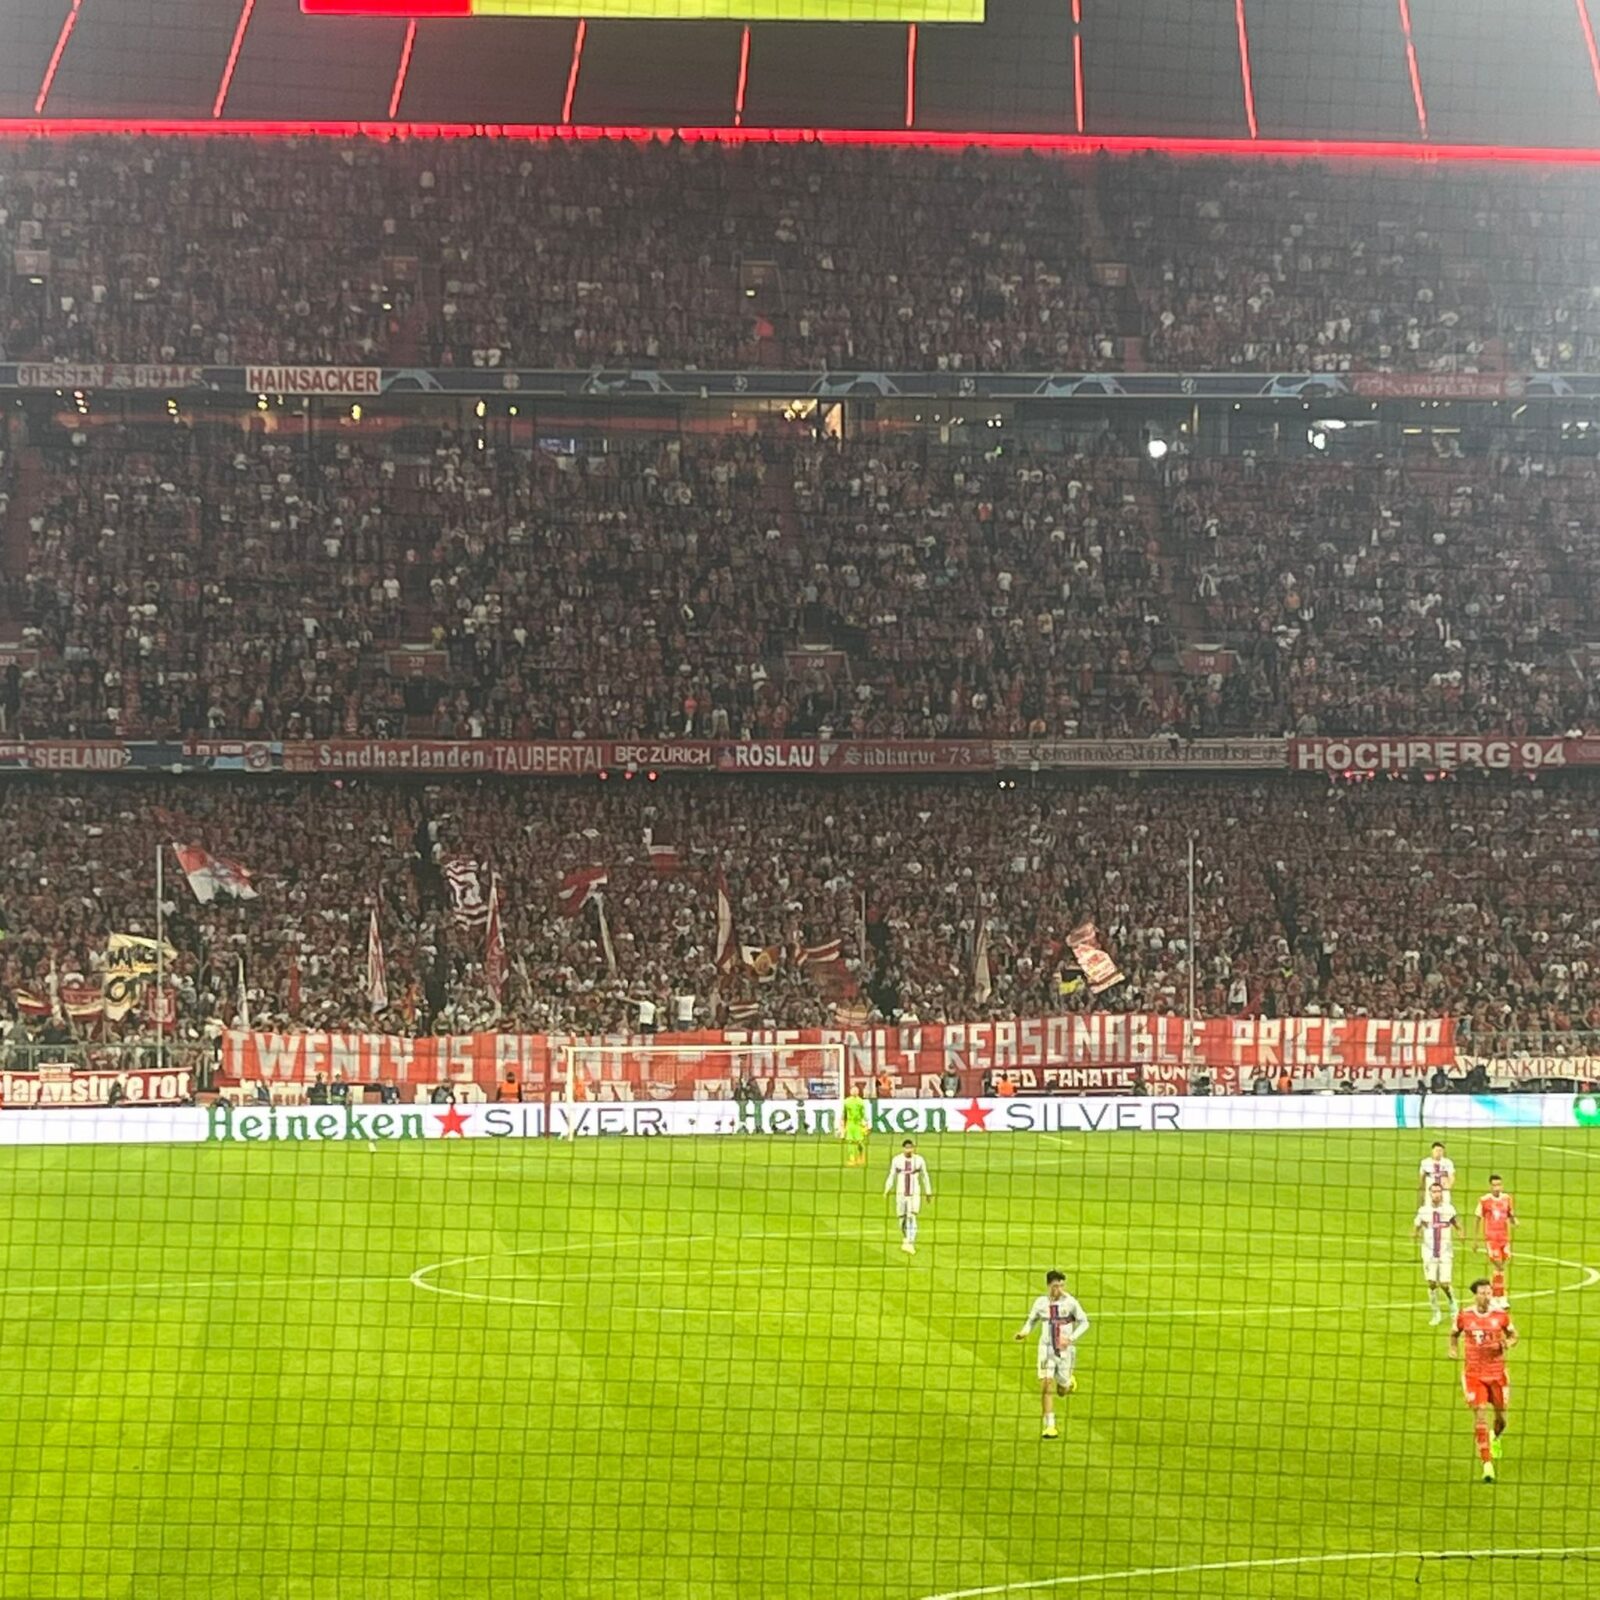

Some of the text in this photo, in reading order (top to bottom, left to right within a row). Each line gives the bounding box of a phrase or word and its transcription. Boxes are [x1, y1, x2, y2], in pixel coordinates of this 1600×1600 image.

[249, 368, 380, 392] HAINSACKER
[34, 747, 123, 769] SEELAND
[226, 1030, 414, 1084] TWENTY
[437, 1033, 475, 1082] IS
[494, 1031, 655, 1083] PLENTY
[724, 1029, 800, 1078] THE
[943, 1012, 1207, 1071] REASONABLE
[1232, 1017, 1349, 1065] PRICE
[1365, 1018, 1441, 1065] CAP
[148, 1071, 191, 1100] rot
[206, 1105, 426, 1140] Heineken
[737, 1099, 1182, 1135] Heinken SILVER
